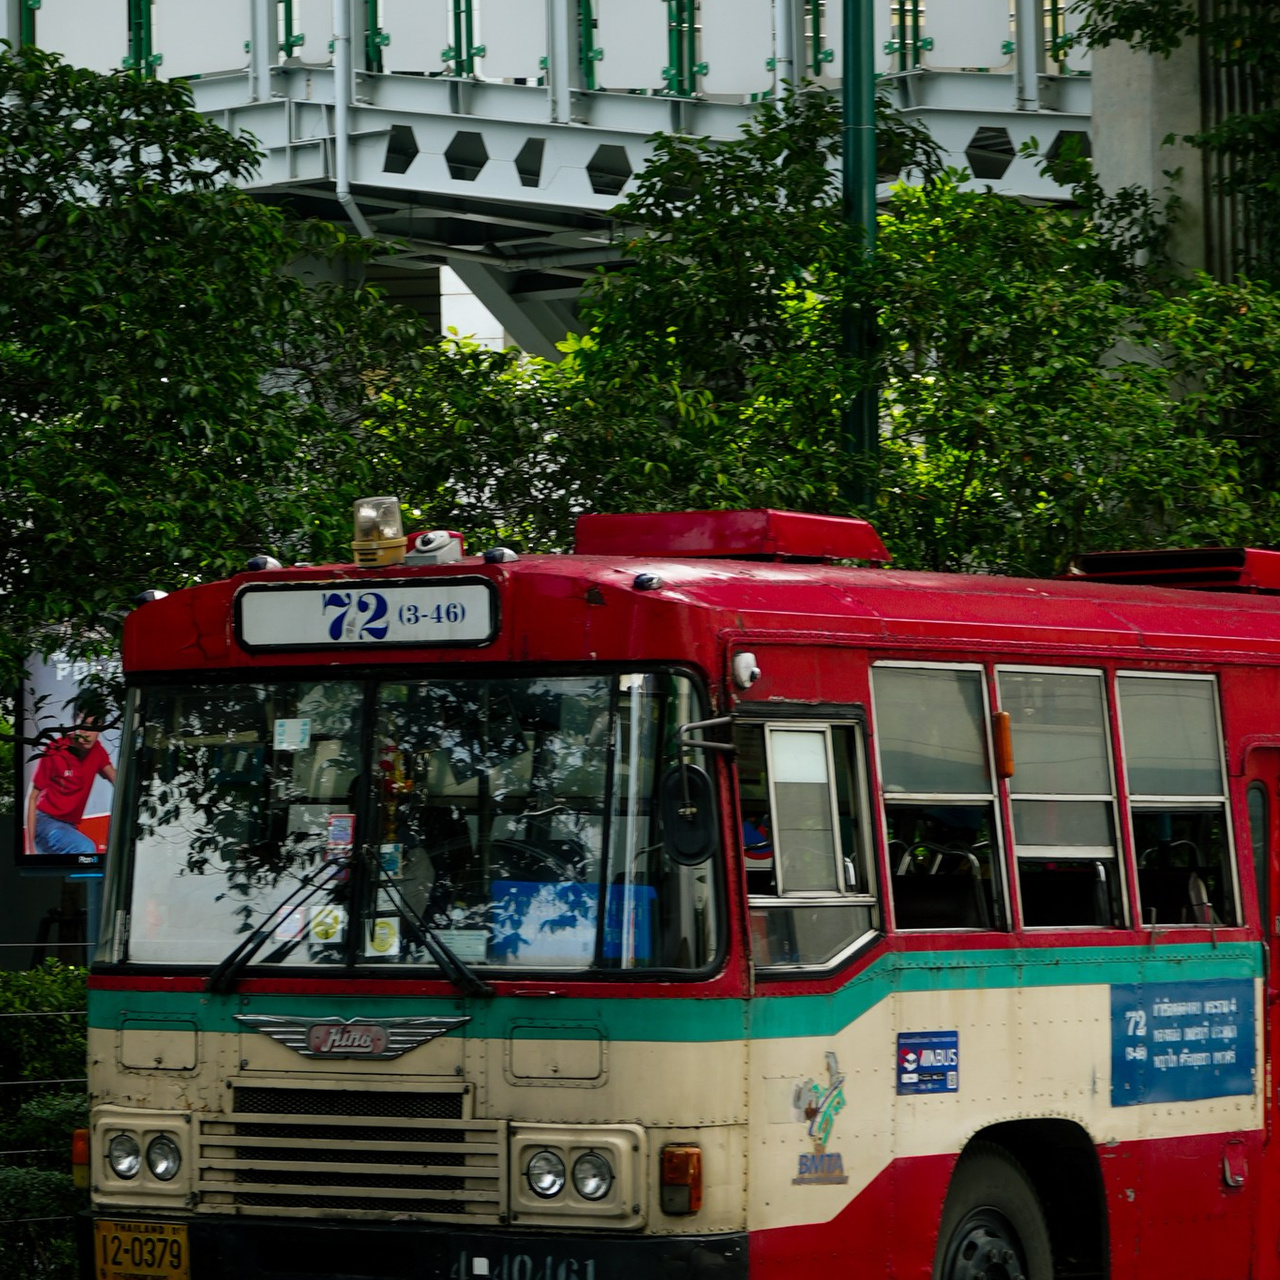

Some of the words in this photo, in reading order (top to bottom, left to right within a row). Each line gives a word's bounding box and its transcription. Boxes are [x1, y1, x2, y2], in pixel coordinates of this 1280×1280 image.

[322, 592, 390, 641] 72
[398, 602, 465, 626] (3-46)
[1125, 1010, 1147, 1036] 72
[321, 1026, 373, 1053] Hino
[798, 1153, 844, 1174] BMTA
[102, 1234, 182, 1270] 12-0379
